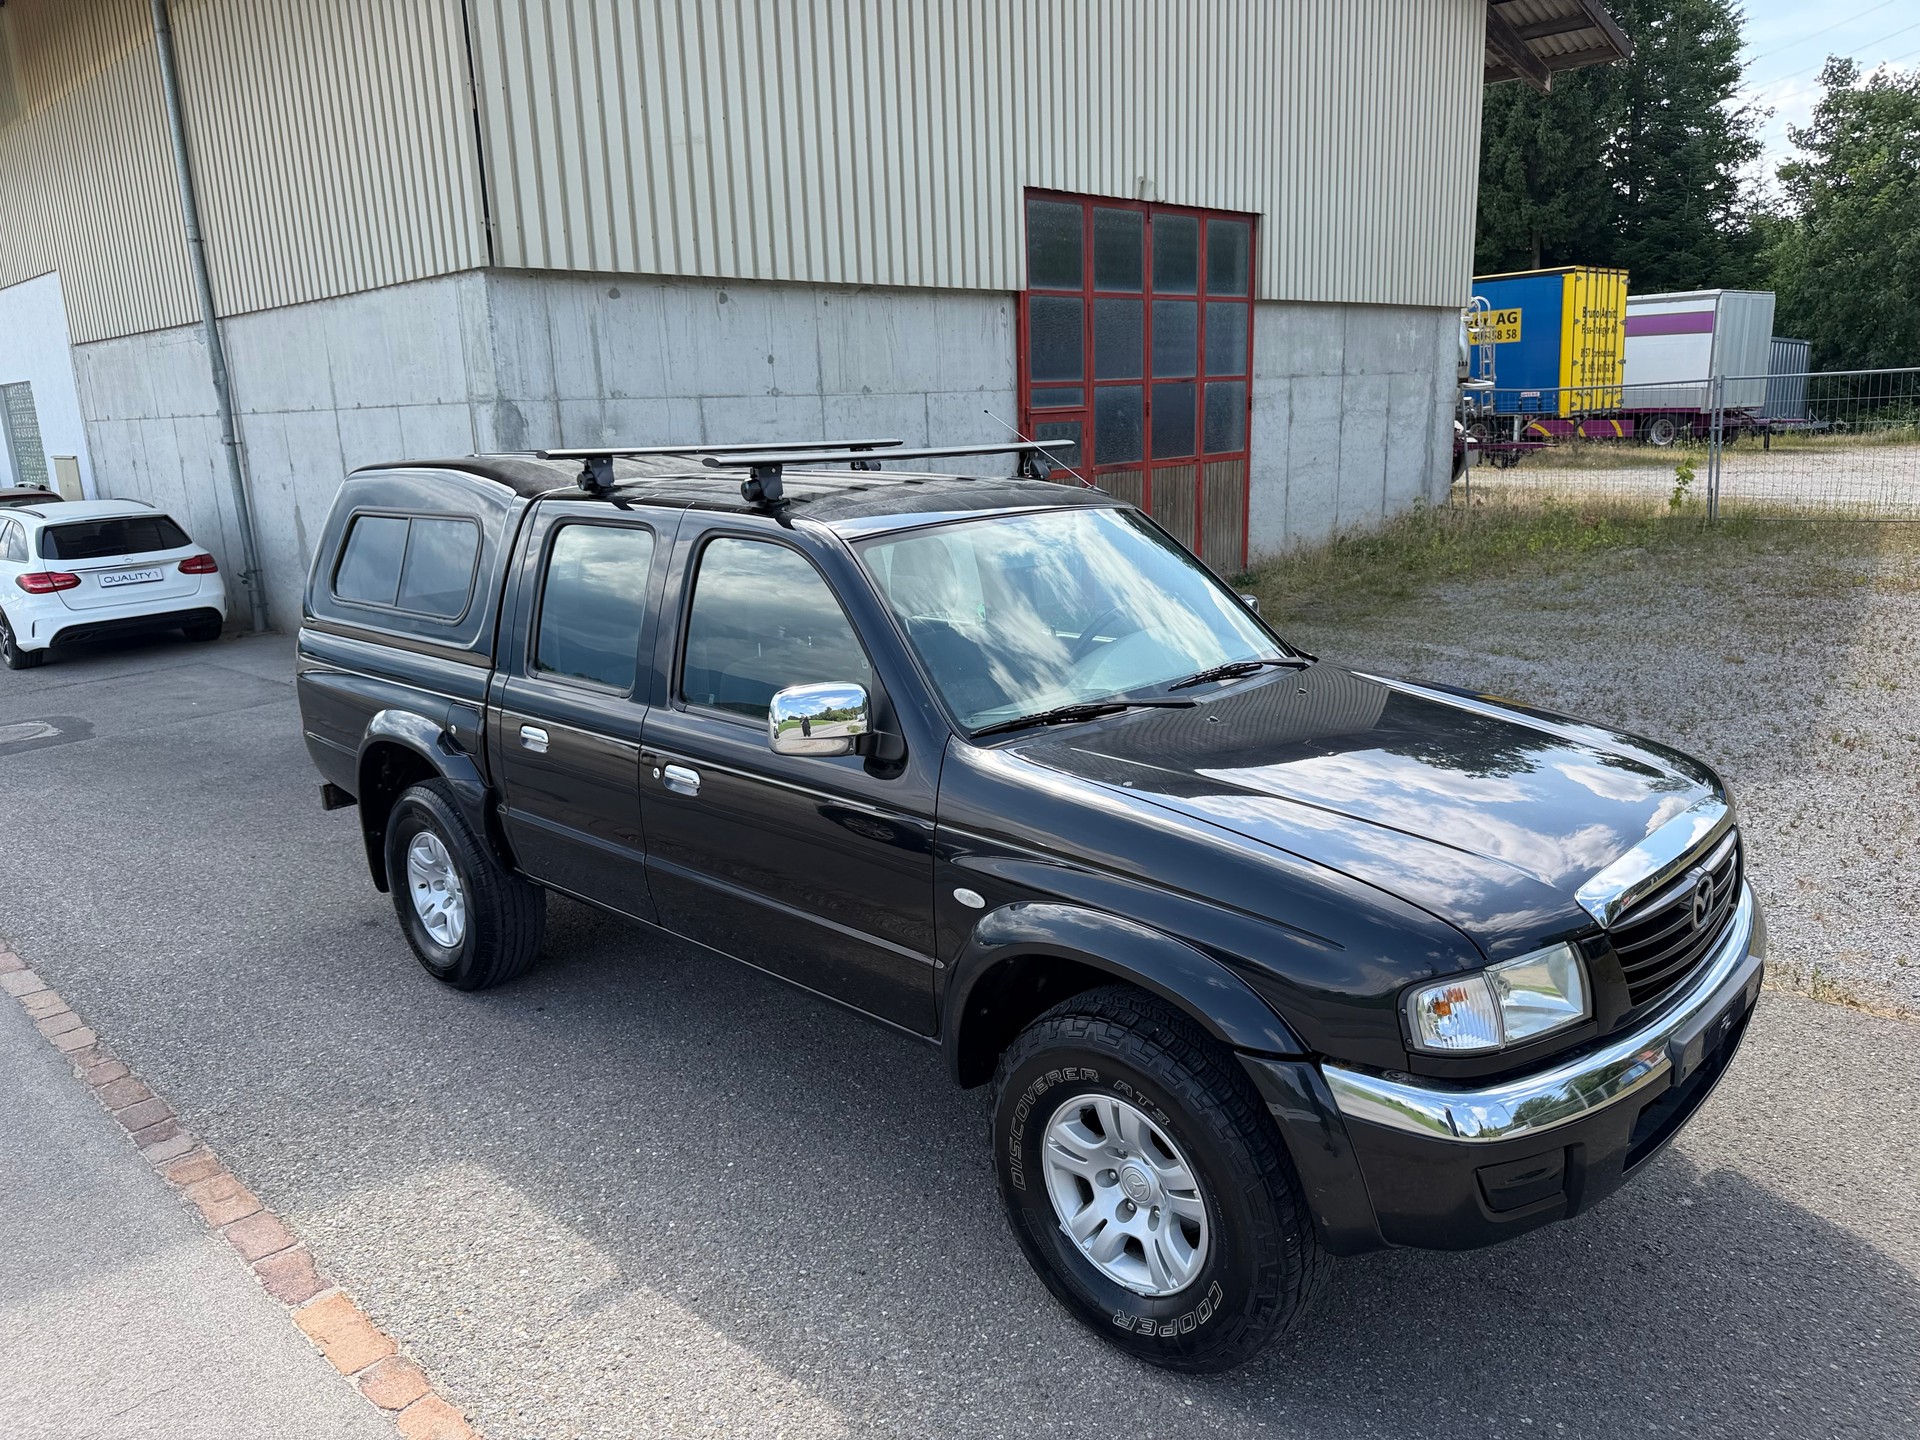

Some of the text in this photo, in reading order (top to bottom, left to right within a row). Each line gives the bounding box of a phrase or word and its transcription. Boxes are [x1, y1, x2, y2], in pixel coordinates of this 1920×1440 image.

[1496, 311, 1518, 325] AG
[1506, 328, 1518, 340] 58
[1581, 347, 1590, 358] 857
[103, 571, 152, 583] QUALITY
[1008, 1067, 1171, 1191] DISCOVERER AT3
[1112, 1280, 1224, 1337] COOPER
